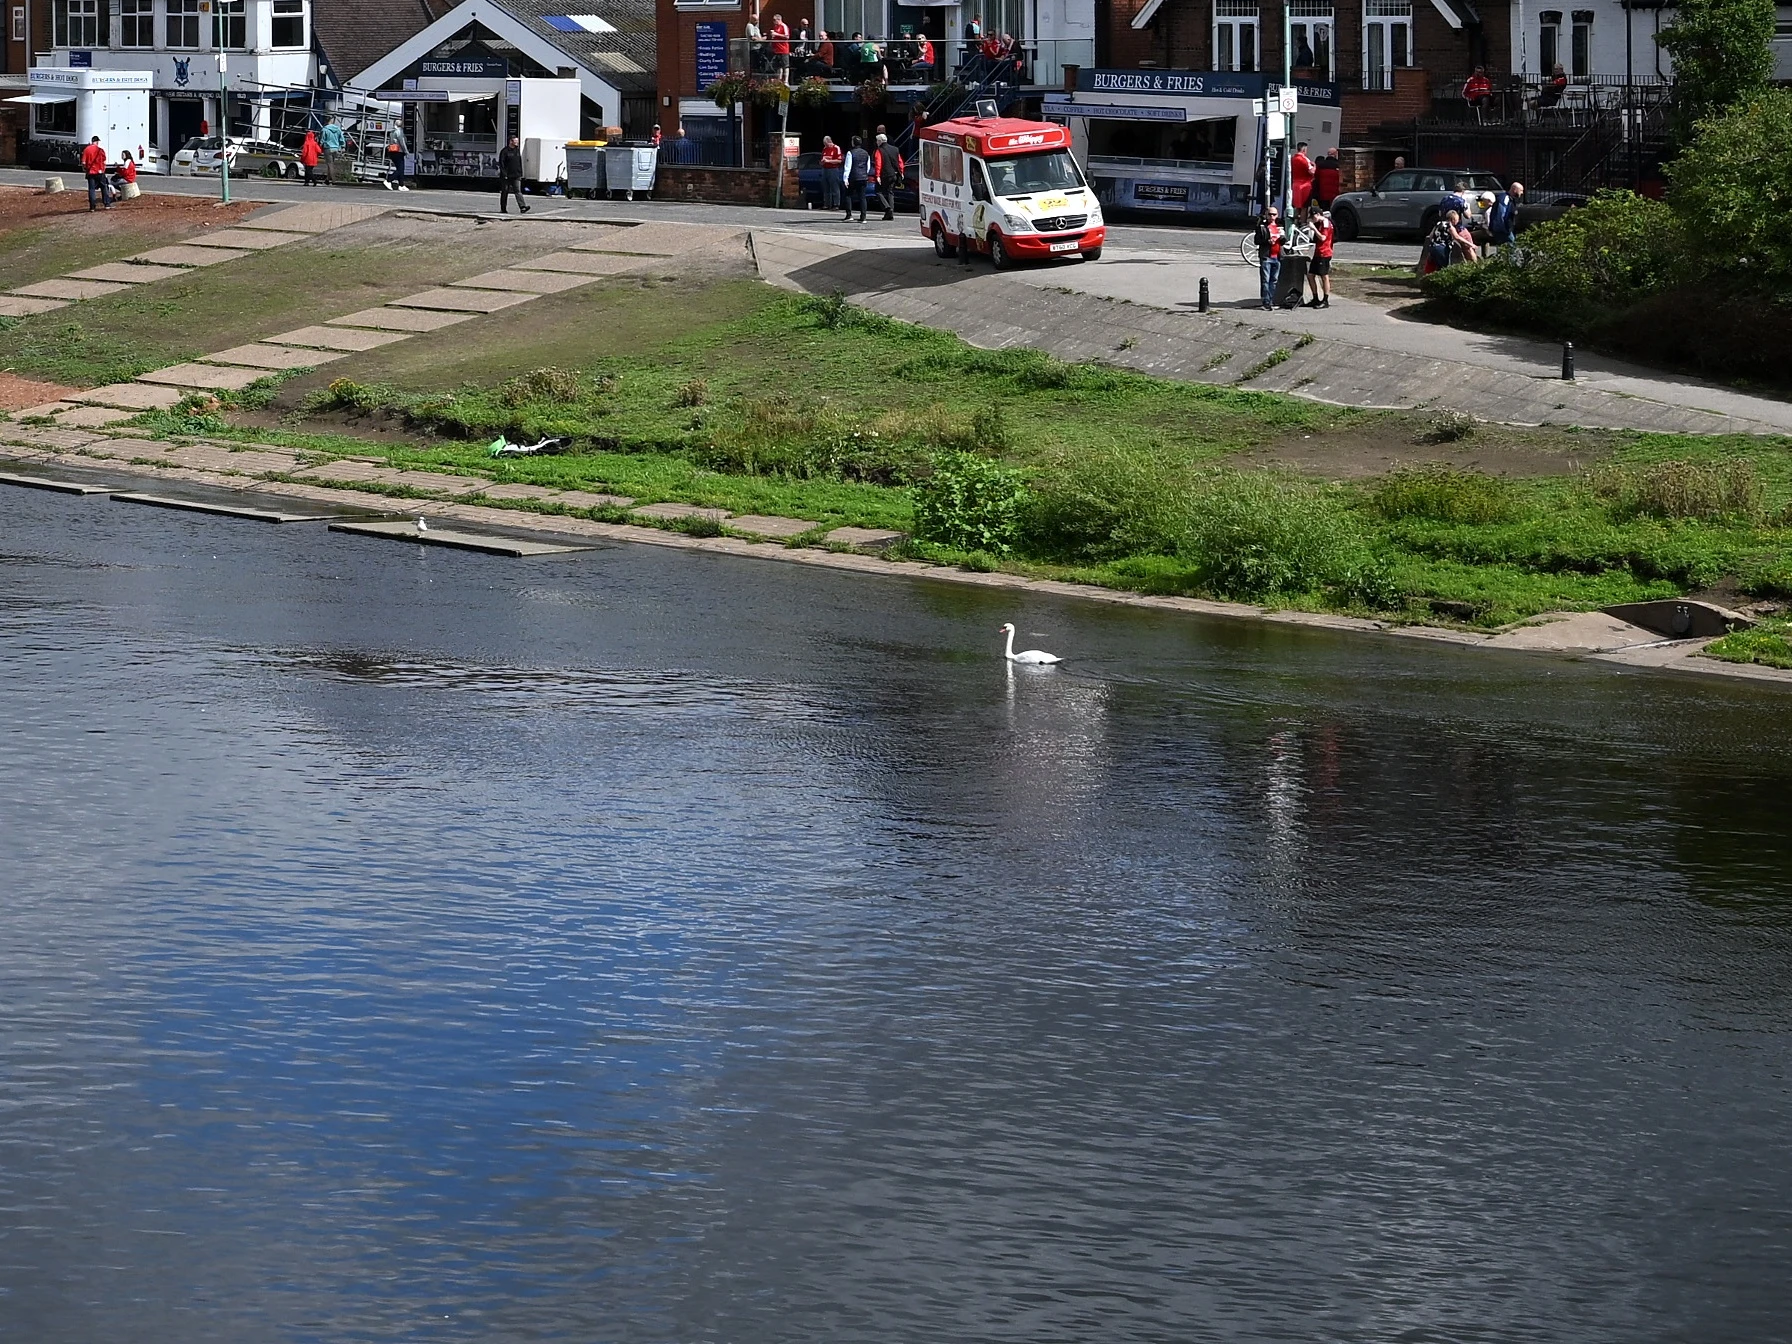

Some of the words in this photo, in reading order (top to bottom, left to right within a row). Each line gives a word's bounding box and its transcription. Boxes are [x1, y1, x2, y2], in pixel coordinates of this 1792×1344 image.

[864, 48, 869, 56] 3
[422, 62, 455, 72] BURGERS
[455, 63, 462, 72] &
[463, 62, 484, 73] FRIES
[1094, 73, 1150, 89] BURGERS
[1153, 76, 1163, 89] &
[1167, 76, 1204, 91] FRIES
[1268, 83, 1303, 95] BURS
[1303, 86, 1310, 95] &
[1310, 87, 1332, 98] FRIES
[1063, 106, 1084, 114] COFFEE
[1106, 108, 1138, 116] CHOCOLATE
[1170, 187, 1187, 195] FRIES
